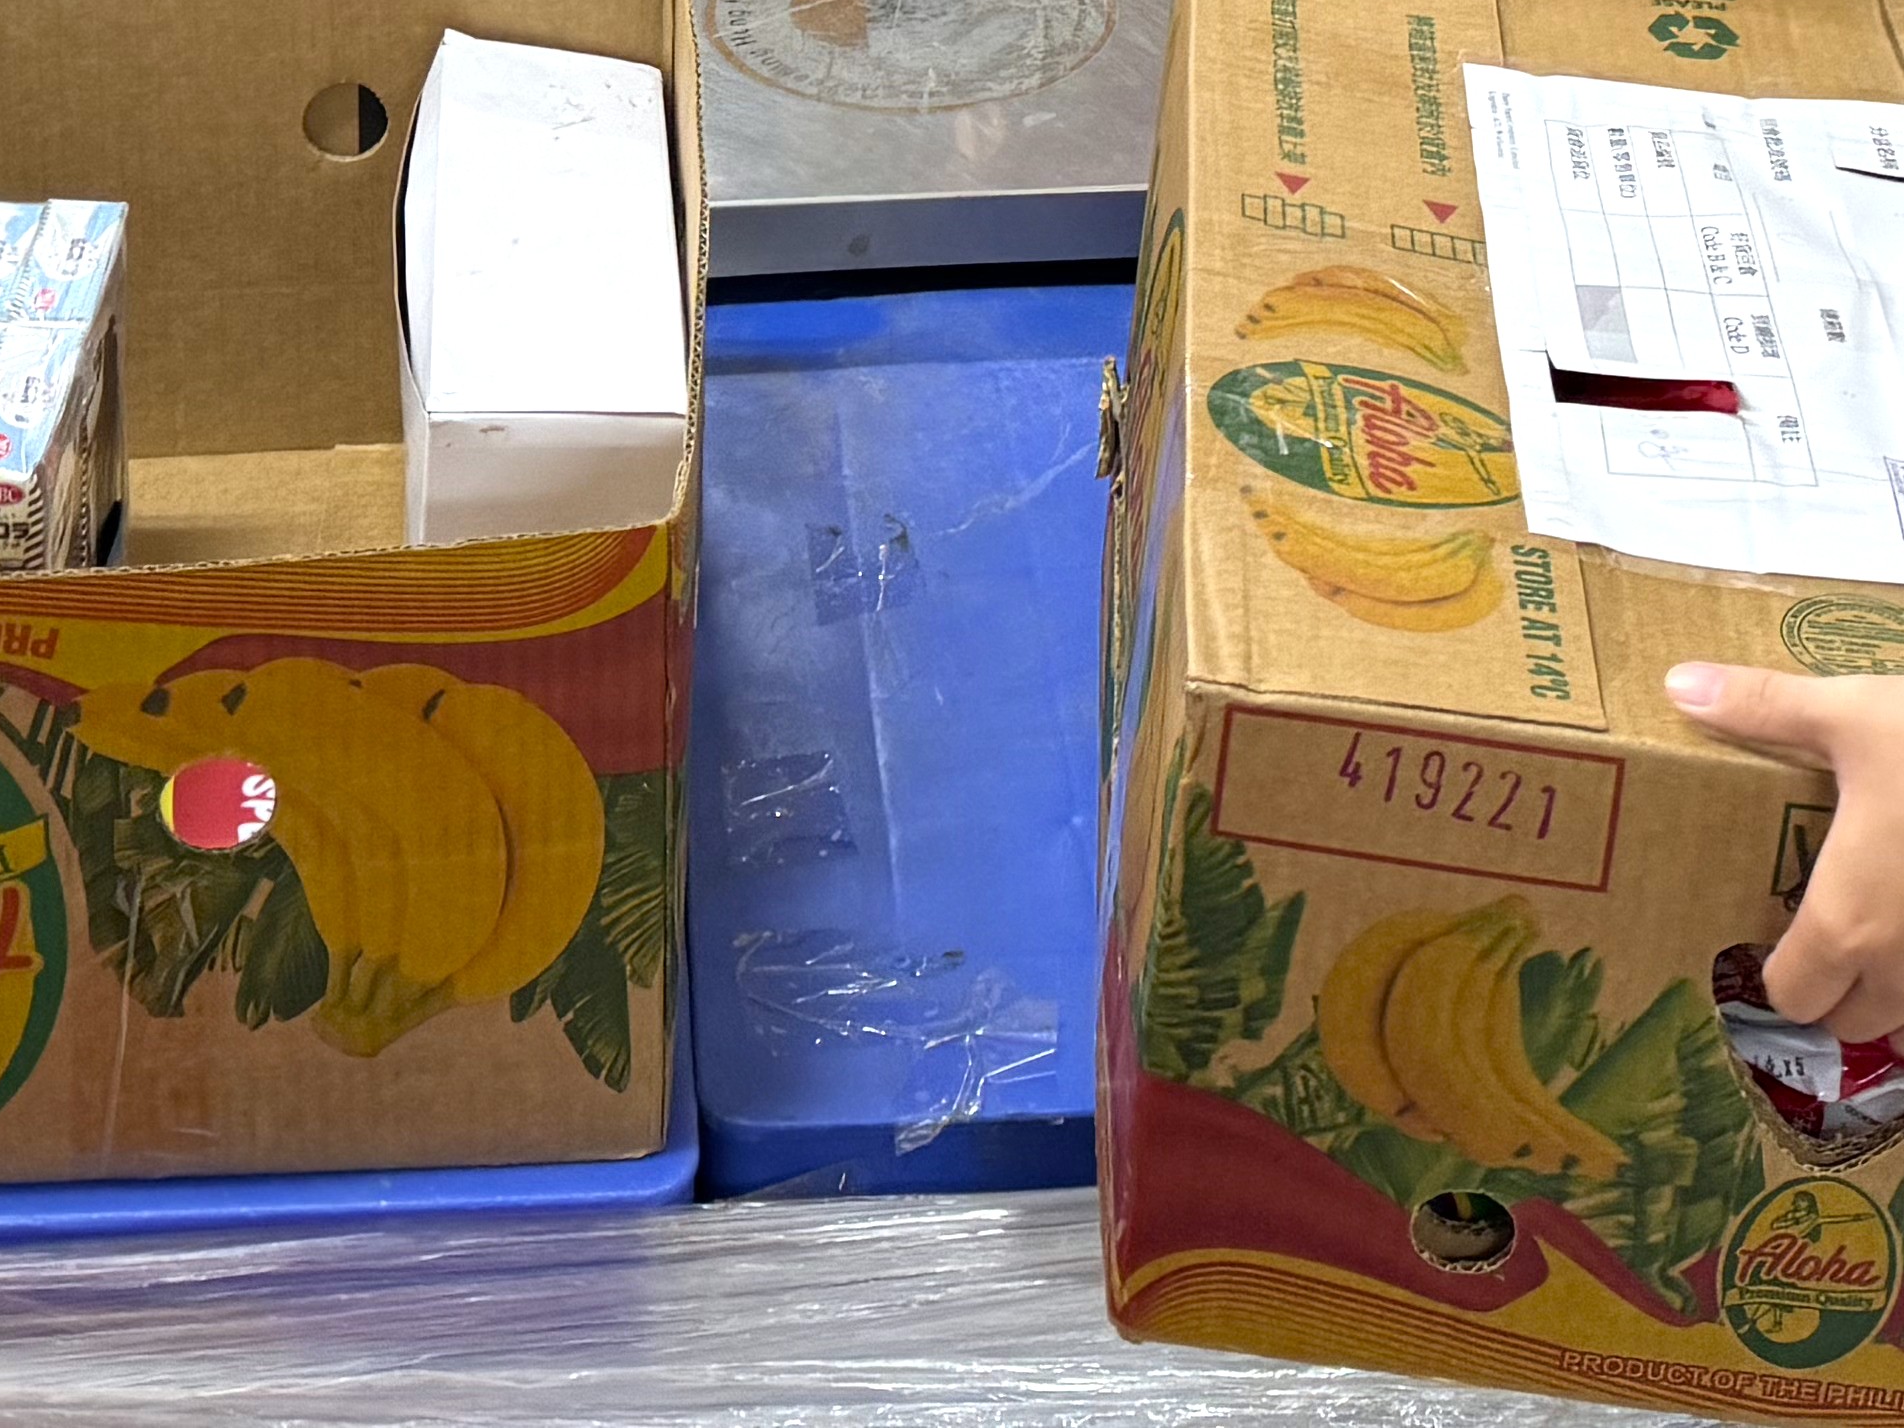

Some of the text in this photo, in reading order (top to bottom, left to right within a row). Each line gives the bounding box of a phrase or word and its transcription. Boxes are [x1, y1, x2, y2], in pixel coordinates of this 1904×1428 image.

[1700, 225, 1721, 252] Code
[1723, 316, 1744, 343] Code
[1340, 374, 1437, 495] Aloha
[1509, 543, 1557, 613] STORE
[1519, 617, 1563, 651] AT
[1338, 731, 1559, 841] 419221
[1736, 1232, 1885, 1289] Aloha
[1739, 1286, 1877, 1311] Premium Quality
[1560, 1350, 1711, 1388] PRODUCT
[1716, 1372, 1756, 1395] OF
[1759, 1374, 1820, 1404] THE
